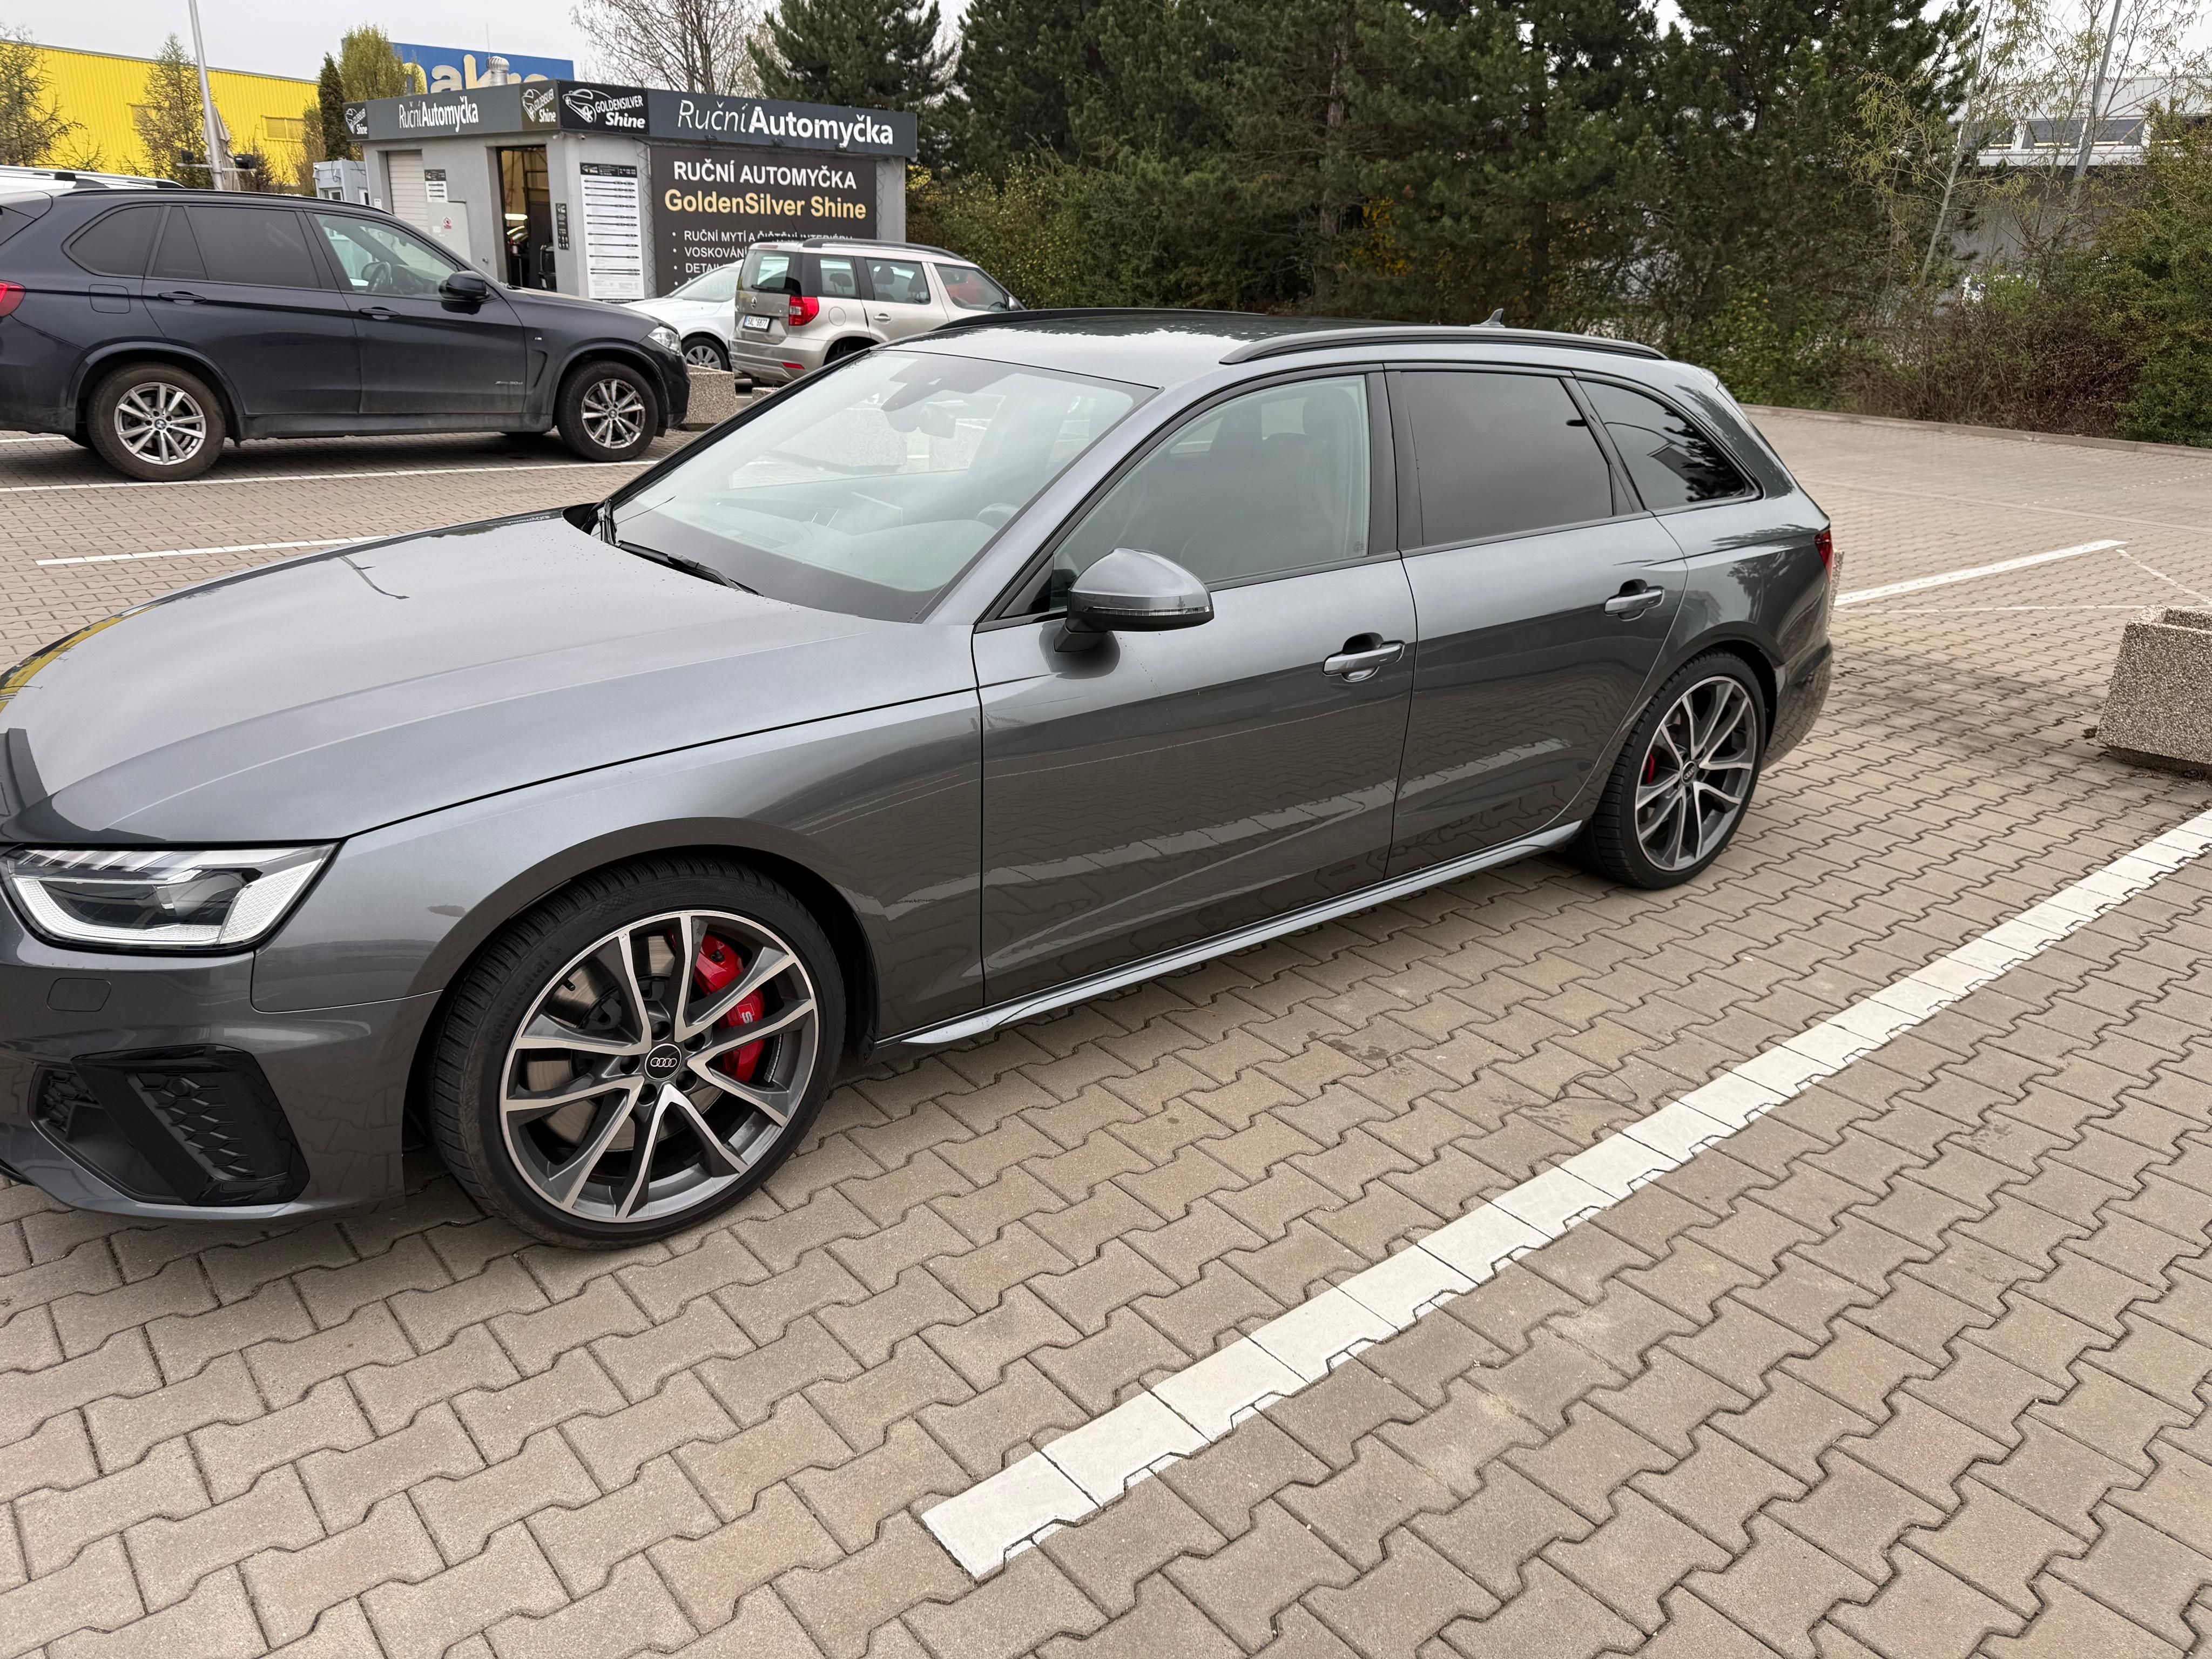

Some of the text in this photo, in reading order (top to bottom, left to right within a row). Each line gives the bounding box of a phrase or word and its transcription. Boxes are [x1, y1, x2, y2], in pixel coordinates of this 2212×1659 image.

[595, 95, 644, 113] GOLDENSILVER
[539, 108, 556, 123] Shine
[605, 112, 645, 129] Shine
[673, 158, 858, 190] RUČNÍ AUTOMYČKA
[664, 189, 867, 220] GoldenSilver Shine
[684, 228, 718, 242] RUČNÍ
[721, 230, 746, 242] MYTÍ
[748, 232, 756, 242] A
